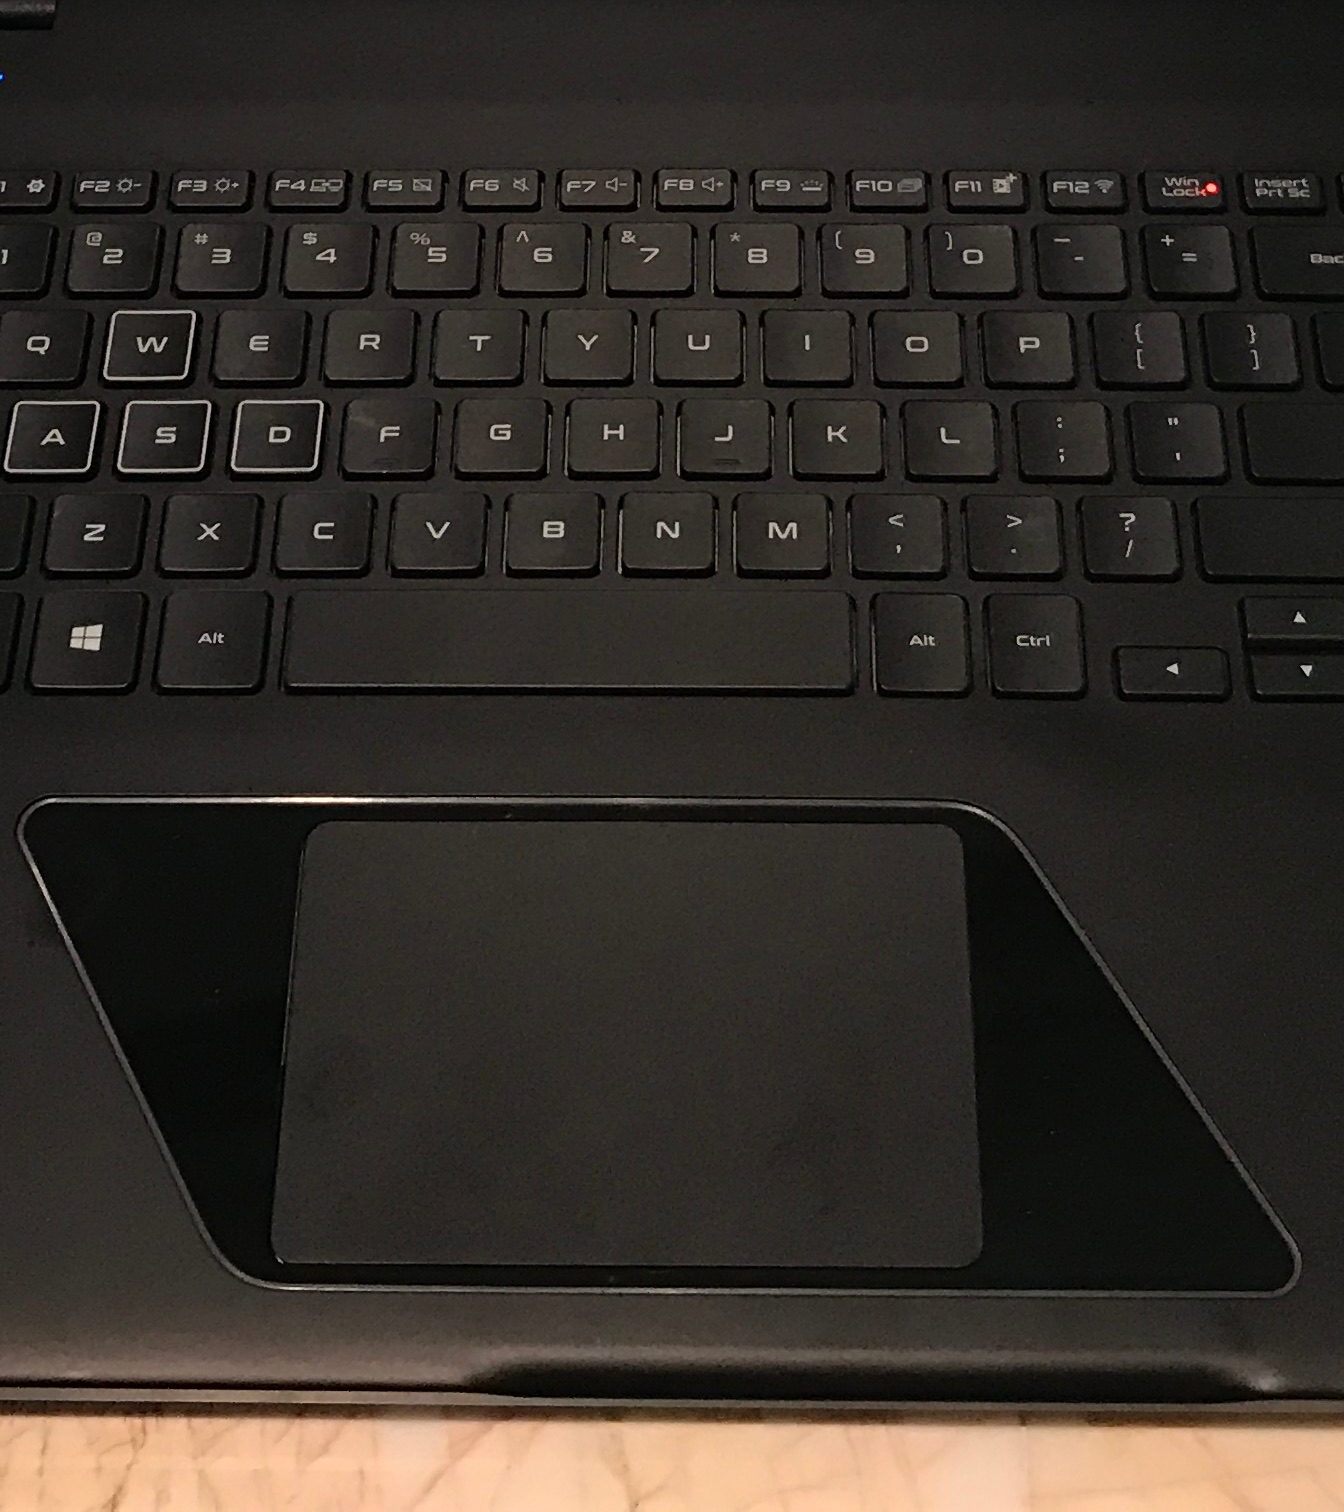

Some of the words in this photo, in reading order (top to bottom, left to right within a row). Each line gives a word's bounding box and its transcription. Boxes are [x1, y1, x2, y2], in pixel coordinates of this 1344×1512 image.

[79, 180, 111, 193] F2
[177, 179, 208, 192] F3
[274, 179, 306, 192] F4
[372, 179, 403, 192] F5
[469, 179, 500, 192] F6
[566, 180, 597, 193] F7
[663, 178, 695, 191] F8
[761, 179, 791, 192] F9
[855, 180, 893, 193] F10
[954, 180, 982, 193] F11
[1052, 180, 1090, 194] F12
[1164, 176, 1200, 187] Win
[1254, 177, 1309, 188] Insert
[1161, 186, 1207, 197] Lock
[1255, 187, 1284, 198] Prt
[1287, 187, 1311, 198] Sc
[85, 231, 103, 247] @
[194, 233, 209, 245] #
[302, 231, 318, 246] $
[409, 232, 431, 245] %
[620, 230, 636, 244] &
[1, 249, 9, 265] 1
[102, 248, 124, 265] 2
[210, 248, 232, 264] 3
[315, 248, 337, 264] 4
[427, 246, 447, 263] 5
[533, 247, 553, 263] 6
[639, 247, 660, 263] 7
[747, 248, 768, 264] 8
[854, 248, 875, 264] 9
[26, 335, 51, 355] Q
[136, 336, 169, 353] W
[248, 335, 270, 352] E
[359, 334, 381, 351] R
[468, 335, 491, 352] T
[577, 334, 599, 351] Y
[687, 334, 711, 351] U
[804, 334, 811, 351] I
[905, 336, 929, 353] O
[1018, 336, 1041, 354] P
[40, 428, 66, 446] A
[154, 426, 177, 444] S
[268, 426, 292, 443] D
[379, 425, 401, 443] F
[489, 423, 512, 441] G
[603, 423, 625, 441] H
[714, 424, 734, 442] J
[827, 425, 848, 443] K
[940, 426, 961, 445] L
[425, 521, 451, 539] V
[542, 520, 565, 539] B
[656, 521, 680, 539] N
[1119, 512, 1136, 532] ?
[83, 523, 106, 542] Z
[197, 522, 221, 541] X
[313, 522, 335, 540] C
[768, 521, 798, 540] M
[197, 631, 225, 644] Alt
[909, 634, 936, 647] Alt
[1016, 634, 1051, 647] Ctrl
